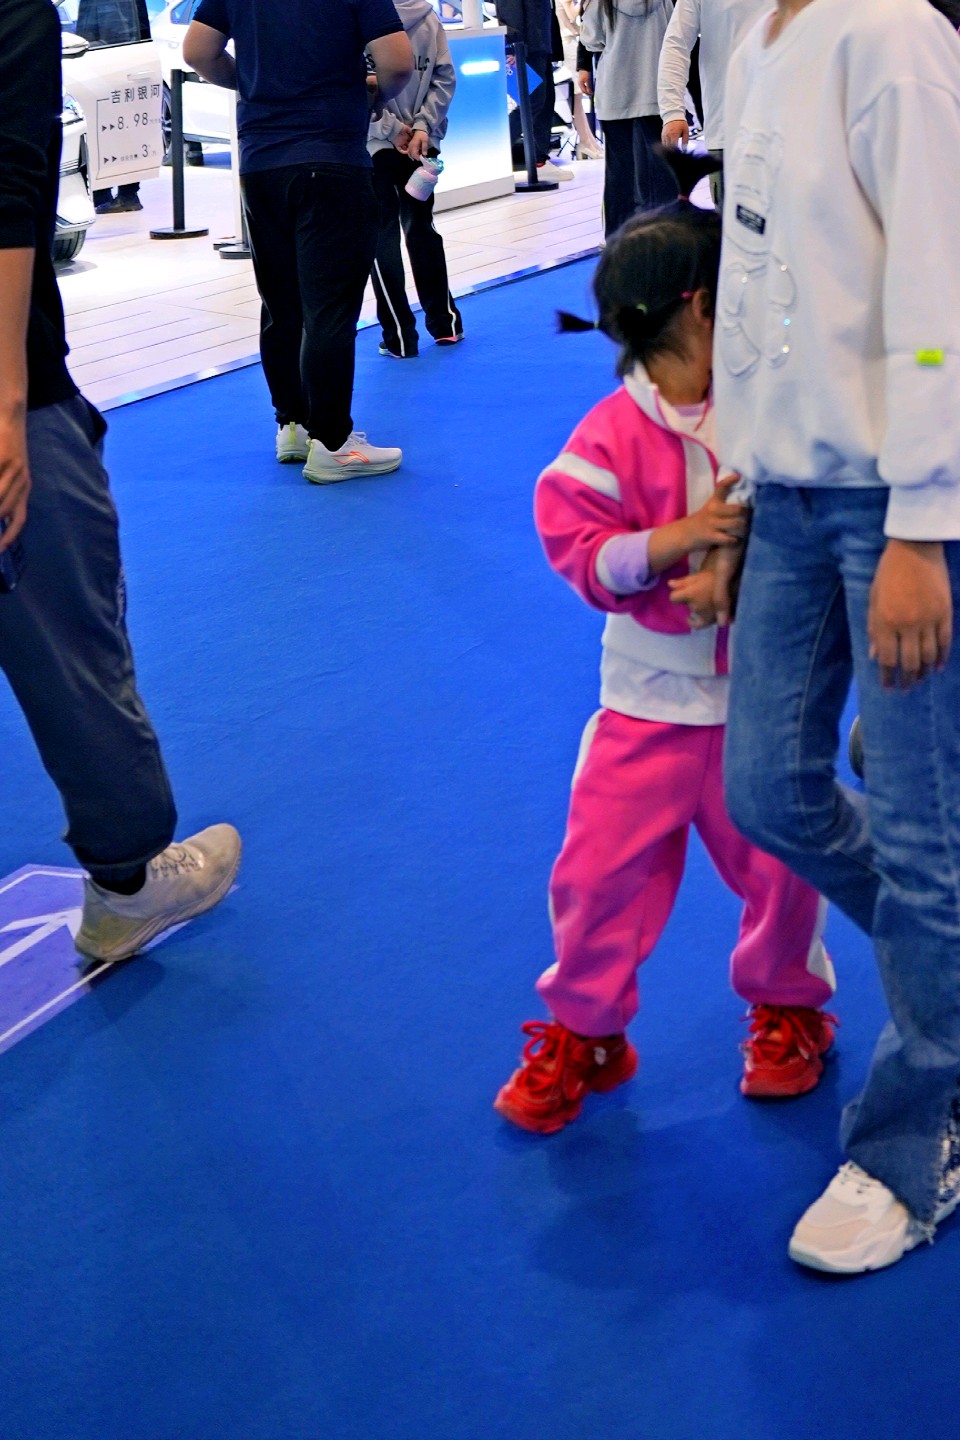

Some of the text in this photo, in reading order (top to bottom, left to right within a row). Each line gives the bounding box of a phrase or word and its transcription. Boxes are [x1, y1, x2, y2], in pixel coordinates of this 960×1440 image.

[111, 84, 160, 104] 吉利银河
[117, 112, 149, 130] 8.98
